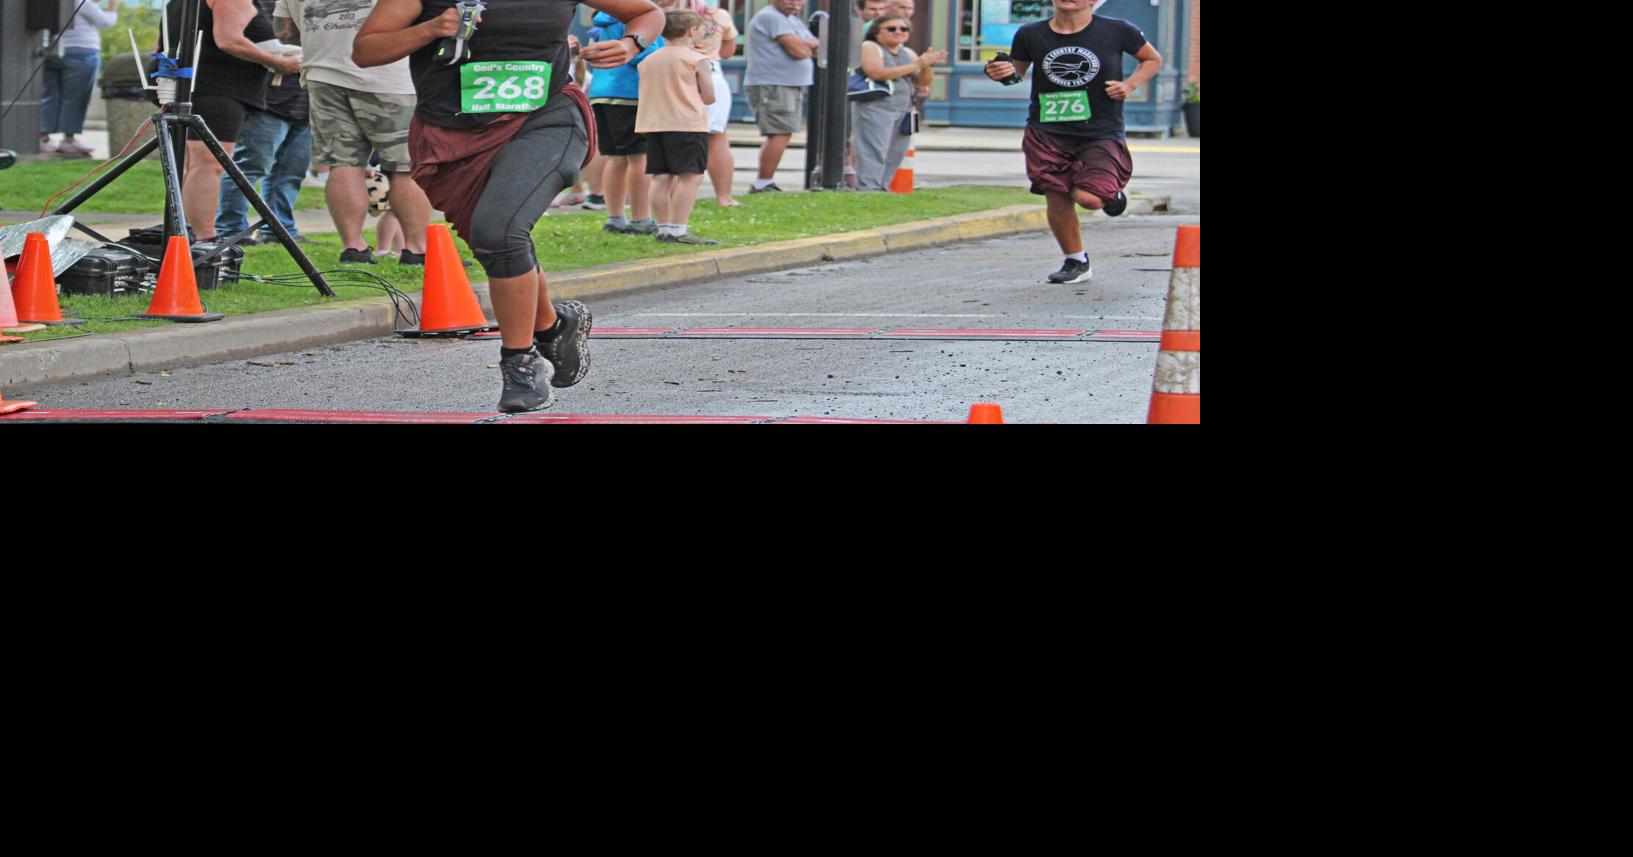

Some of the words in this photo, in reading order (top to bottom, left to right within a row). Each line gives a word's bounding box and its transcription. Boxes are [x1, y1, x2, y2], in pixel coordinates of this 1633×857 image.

[505, 63, 545, 72] Country
[472, 75, 545, 100] 268
[1045, 100, 1085, 115] 276
